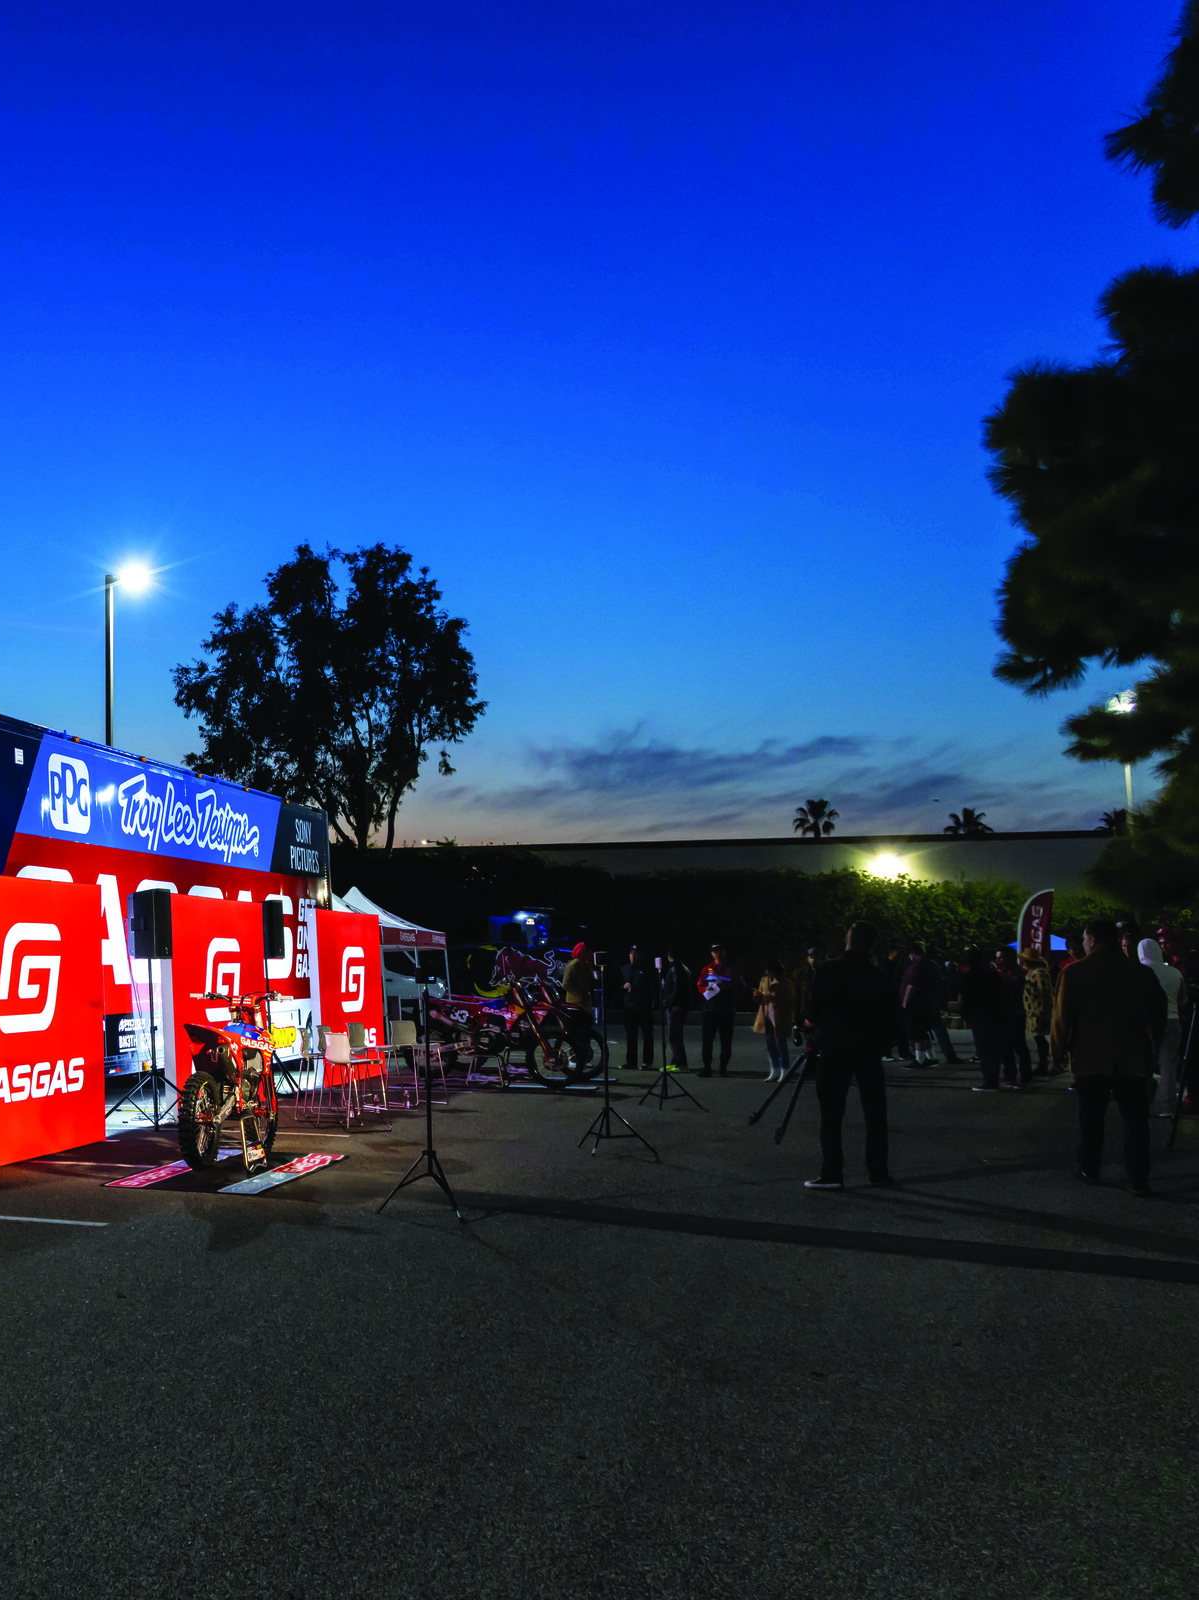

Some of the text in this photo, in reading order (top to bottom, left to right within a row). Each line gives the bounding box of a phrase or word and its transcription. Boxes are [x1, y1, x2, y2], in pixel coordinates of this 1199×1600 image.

[118, 773, 260, 863] Troy Lee Designs
[295, 818, 312, 845] SONY
[289, 845, 320, 874] PICTURES
[450, 1008, 469, 1024] 33
[481, 1006, 518, 1020] GASGAS
[240, 1036, 275, 1053] GASGAS
